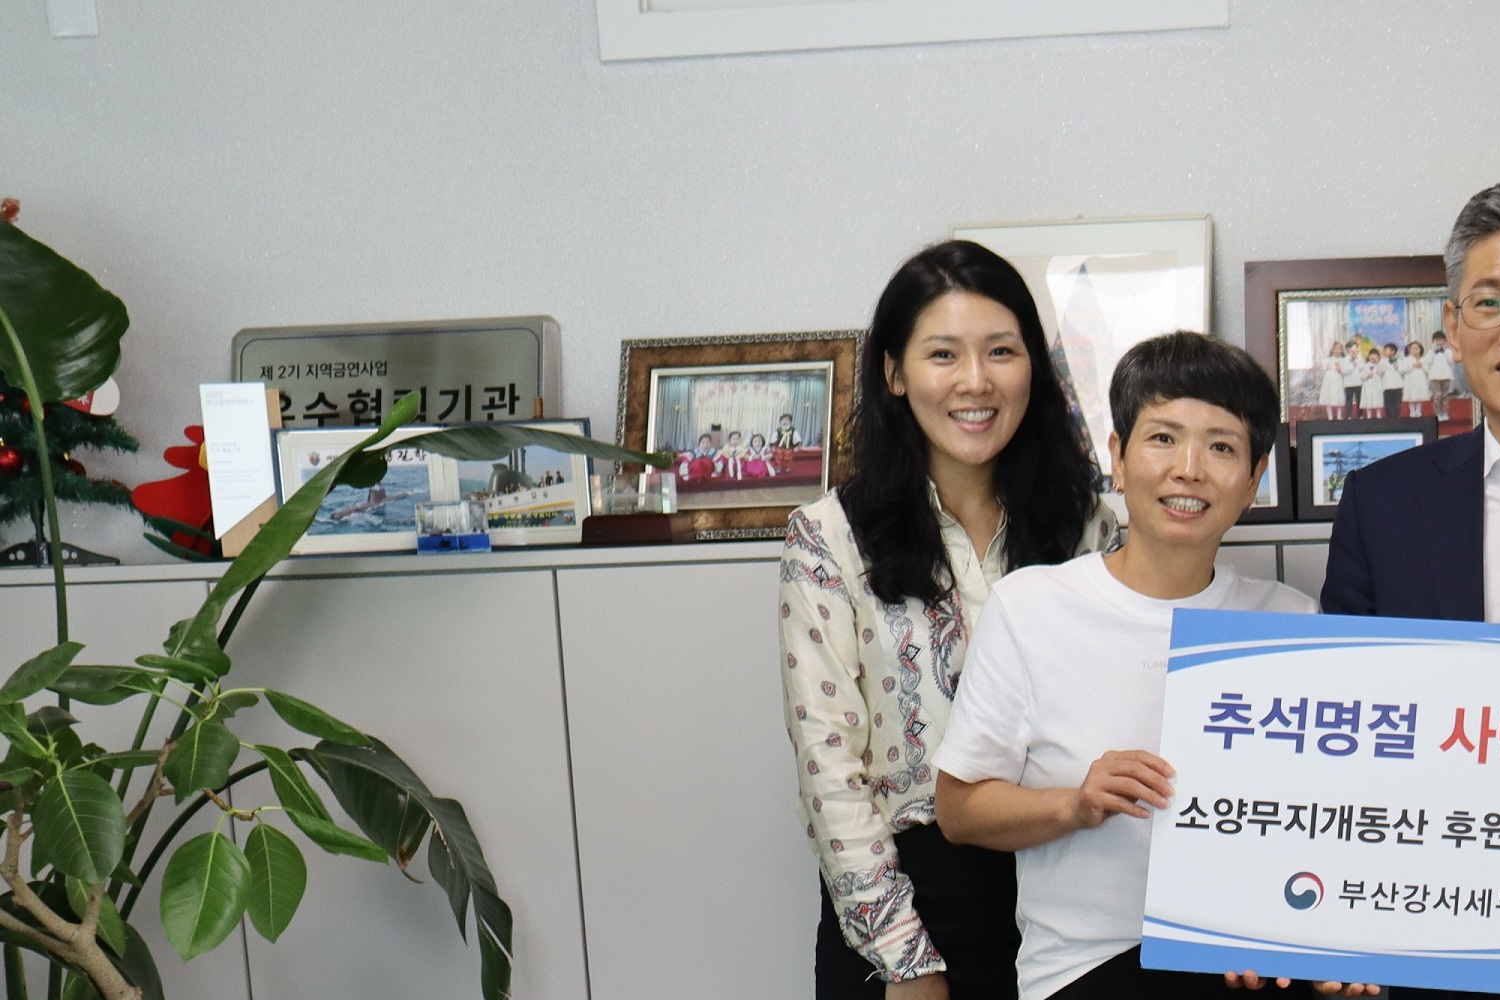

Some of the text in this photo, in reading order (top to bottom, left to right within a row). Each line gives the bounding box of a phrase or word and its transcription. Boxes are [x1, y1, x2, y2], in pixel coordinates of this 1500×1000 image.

[260, 360, 388, 380] 제 2기 지역금연사업
[1203, 692, 1418, 759] 추석명절
[1176, 797, 1428, 845] 소양무지개동산
